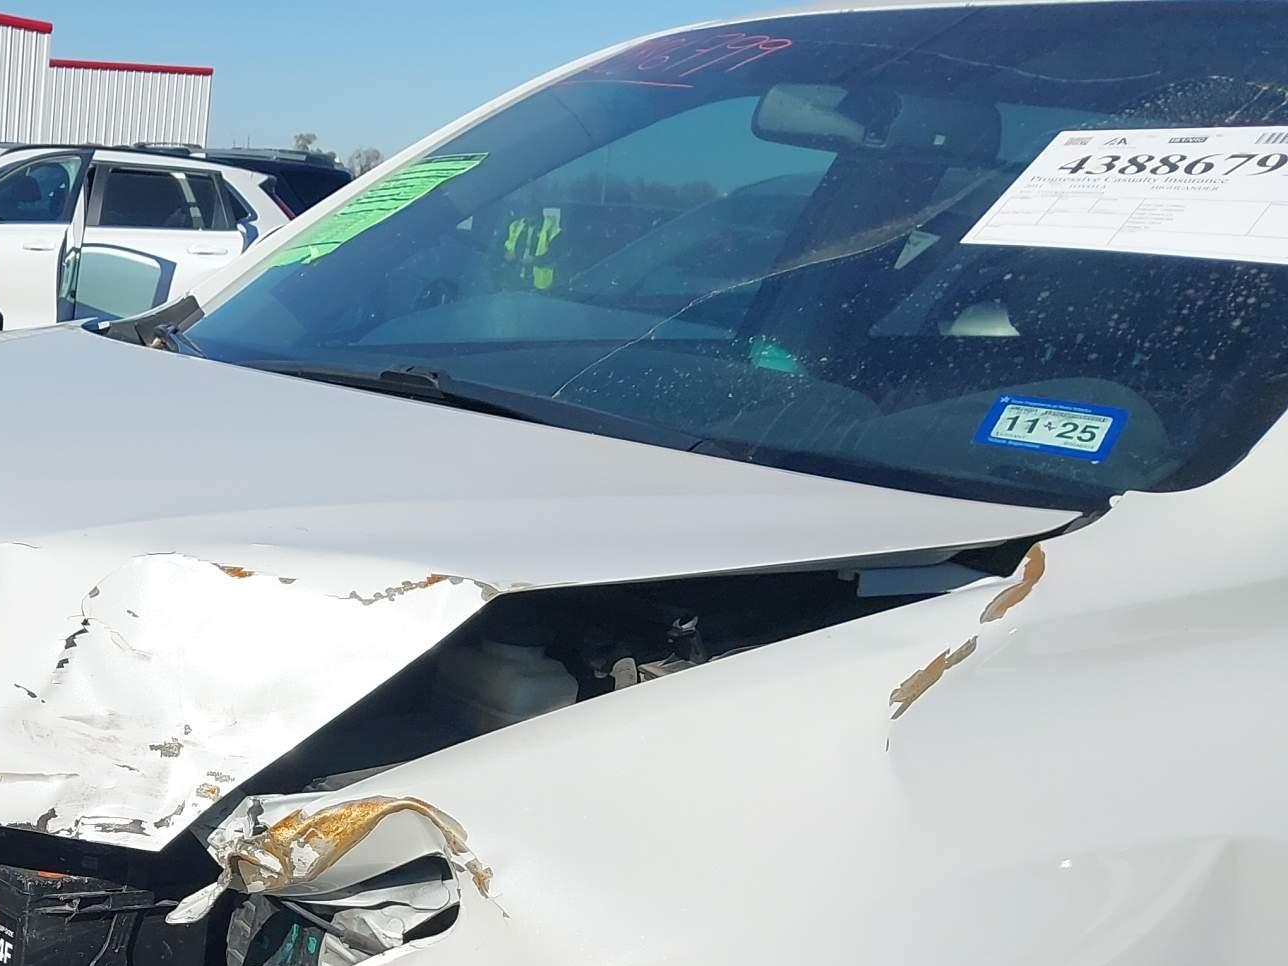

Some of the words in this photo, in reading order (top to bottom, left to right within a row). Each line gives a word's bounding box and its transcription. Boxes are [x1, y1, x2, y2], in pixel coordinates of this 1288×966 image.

[1058, 153, 1288, 177] 4388679
[1030, 175, 1100, 184] Progressive
[1104, 175, 1159, 185] Casualty
[1163, 176, 1231, 185] Insurance
[1007, 415, 1040, 434] 11
[1055, 421, 1100, 443] 25
